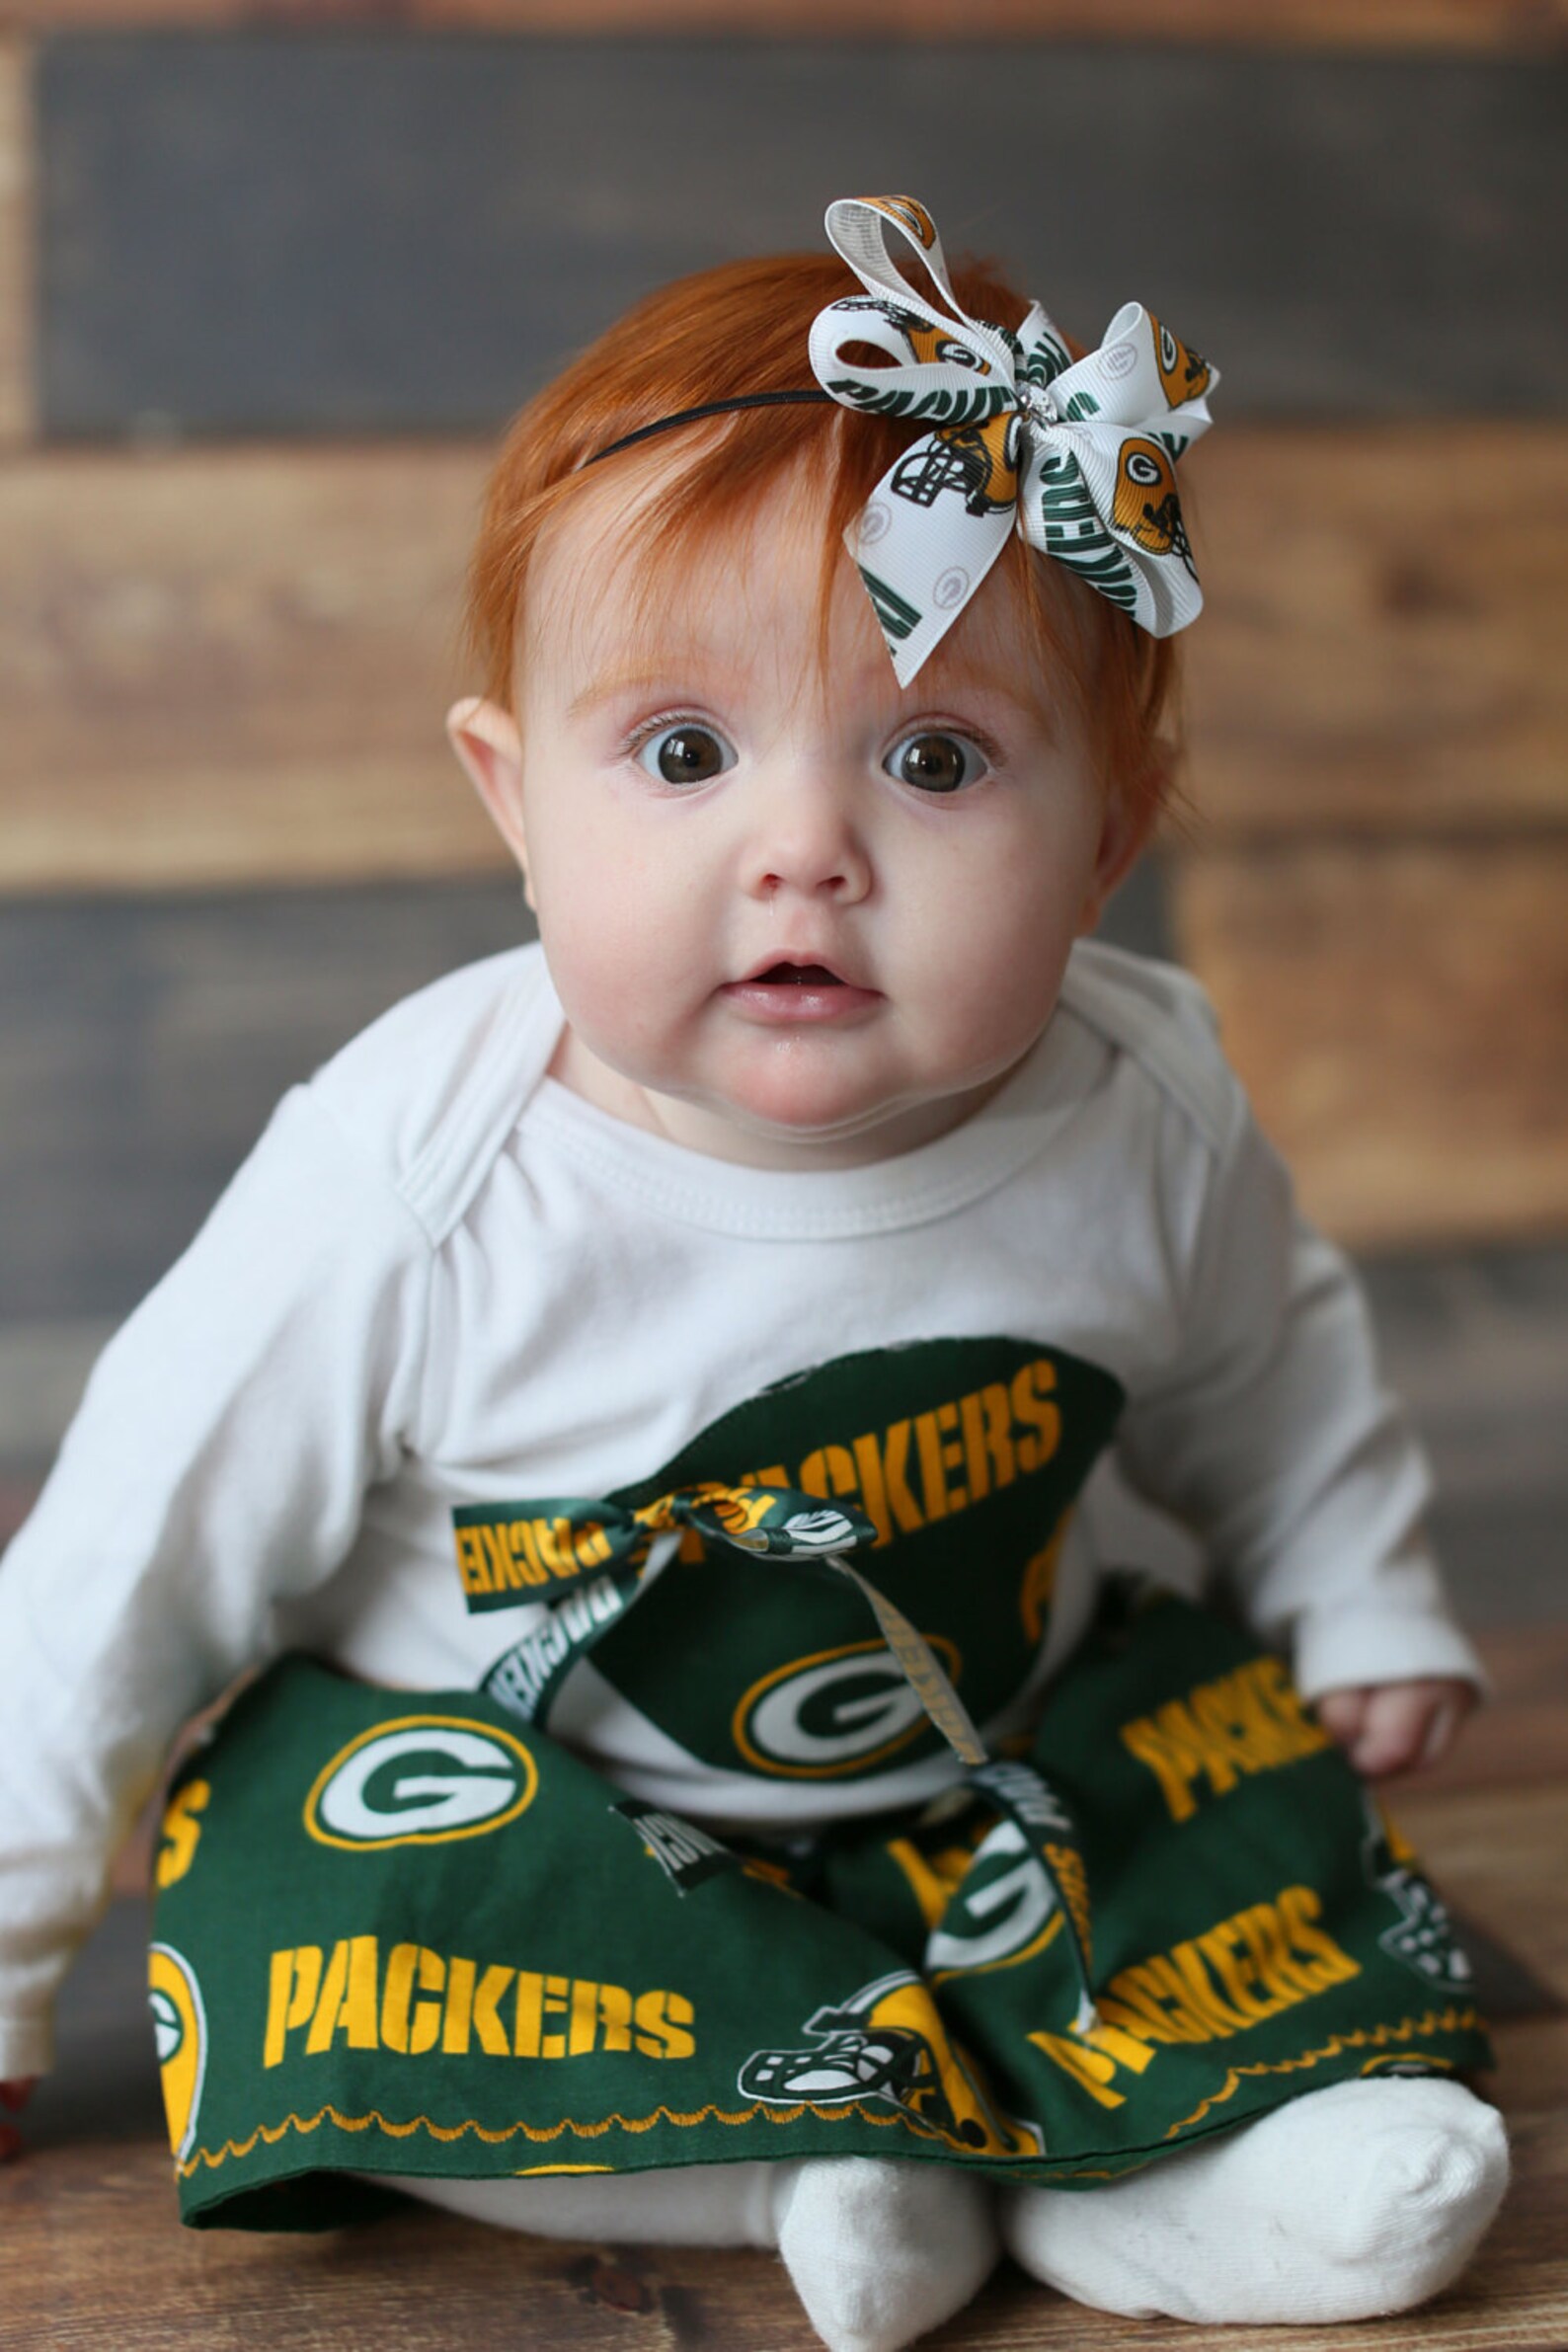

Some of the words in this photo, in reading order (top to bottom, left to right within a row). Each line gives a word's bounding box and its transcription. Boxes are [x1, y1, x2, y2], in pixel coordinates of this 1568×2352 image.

[1125, 451, 1162, 487] G
[318, 1726, 519, 1841] G
[263, 1934, 697, 2071] PACKERS
